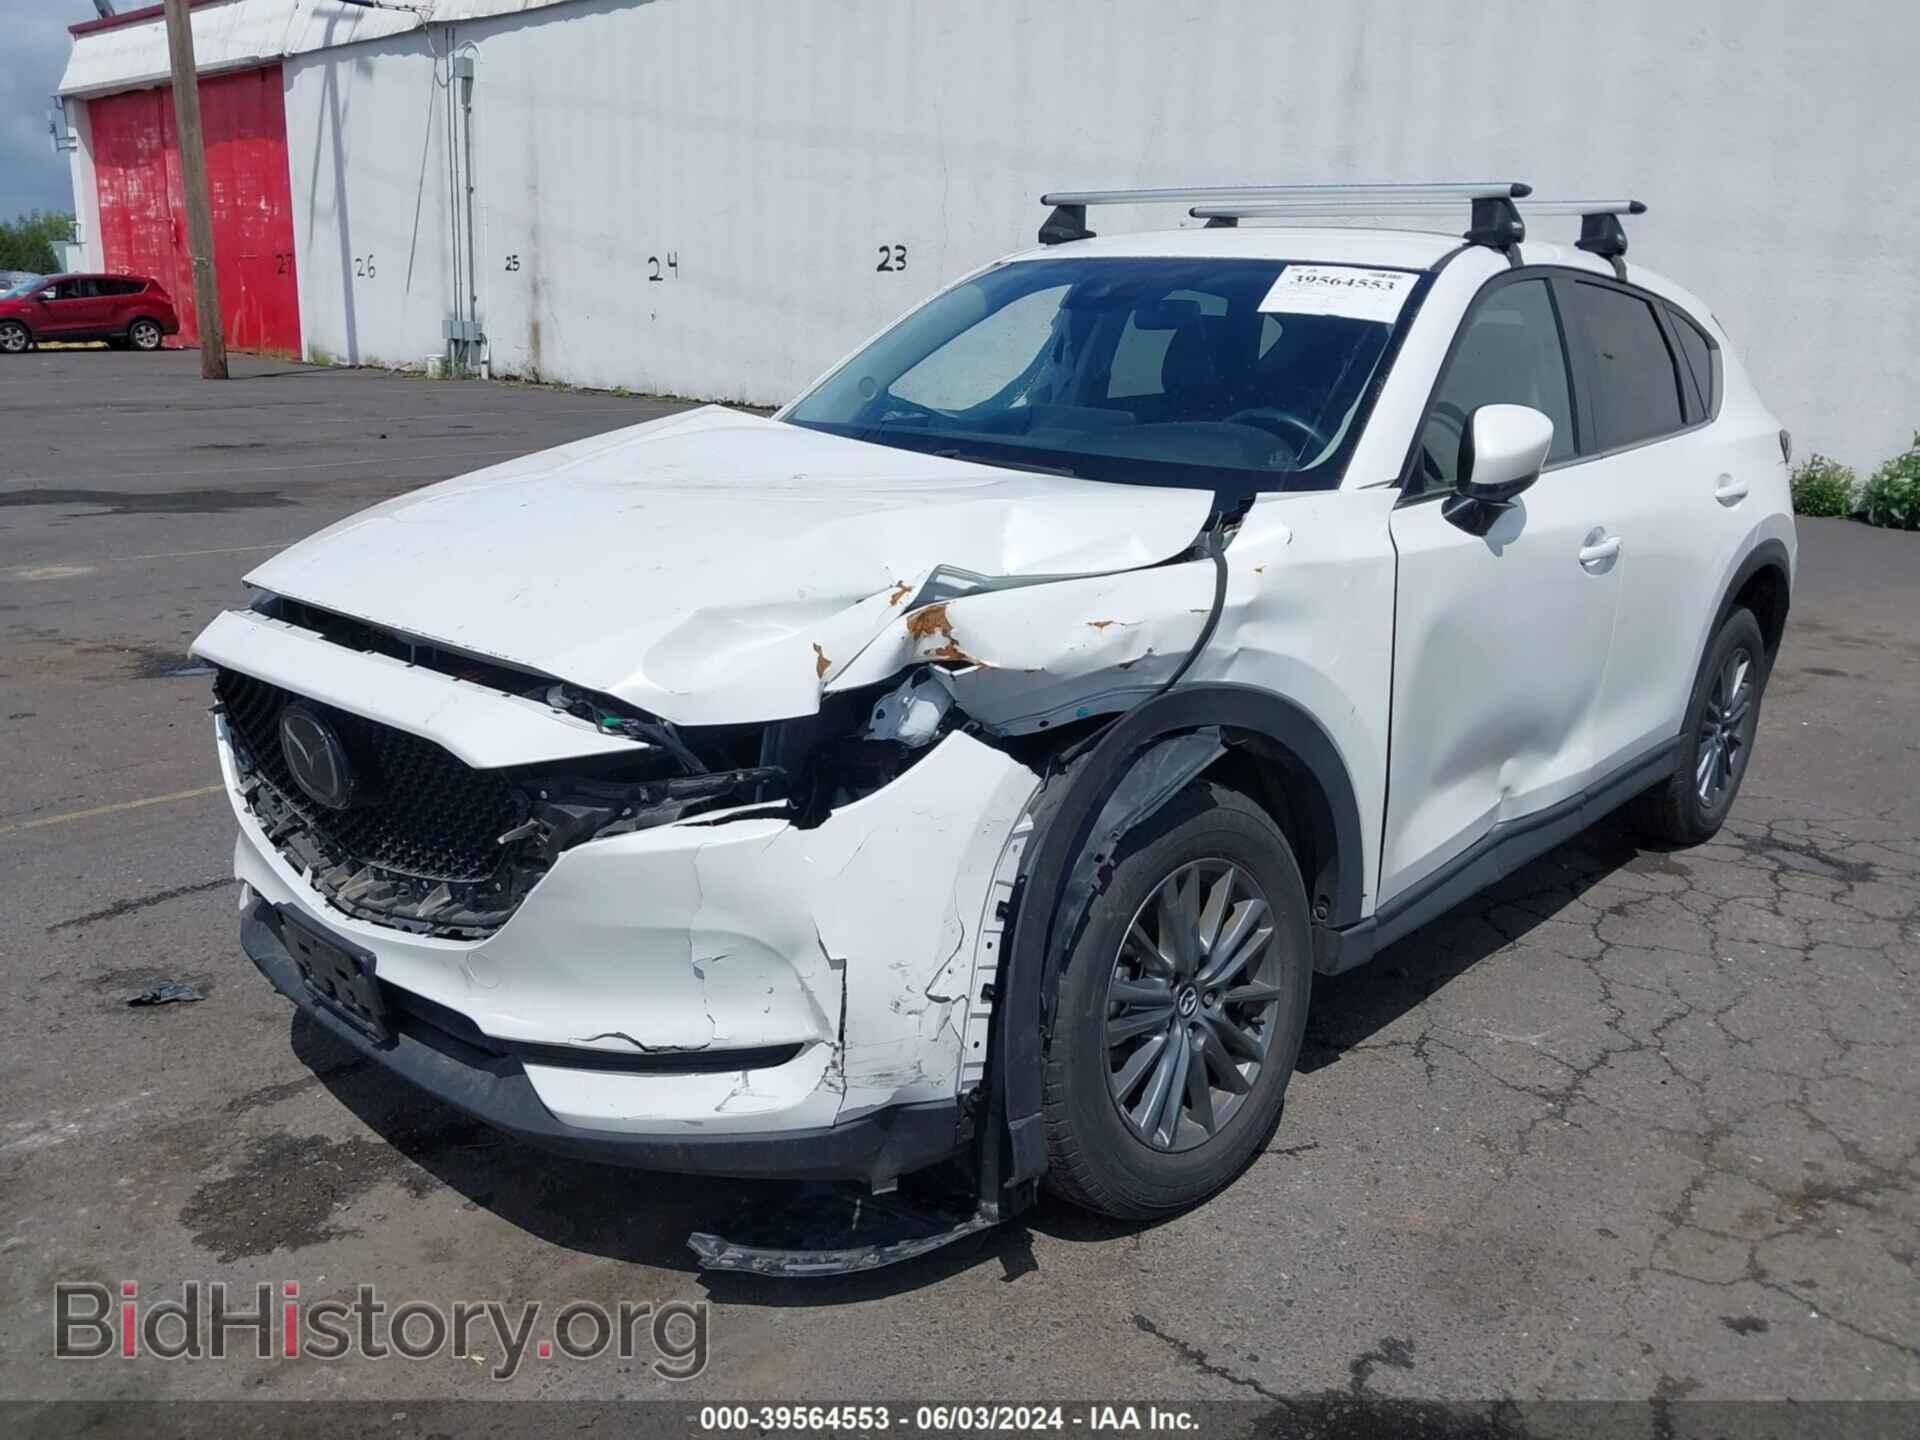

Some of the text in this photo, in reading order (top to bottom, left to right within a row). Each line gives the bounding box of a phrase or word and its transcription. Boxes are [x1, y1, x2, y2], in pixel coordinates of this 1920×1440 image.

[275, 253, 293, 275] 27
[355, 254, 376, 279] 26
[505, 254, 520, 272] 25
[647, 251, 678, 282] 24
[876, 244, 906, 272] 23
[1295, 274, 1396, 291] 39564553
